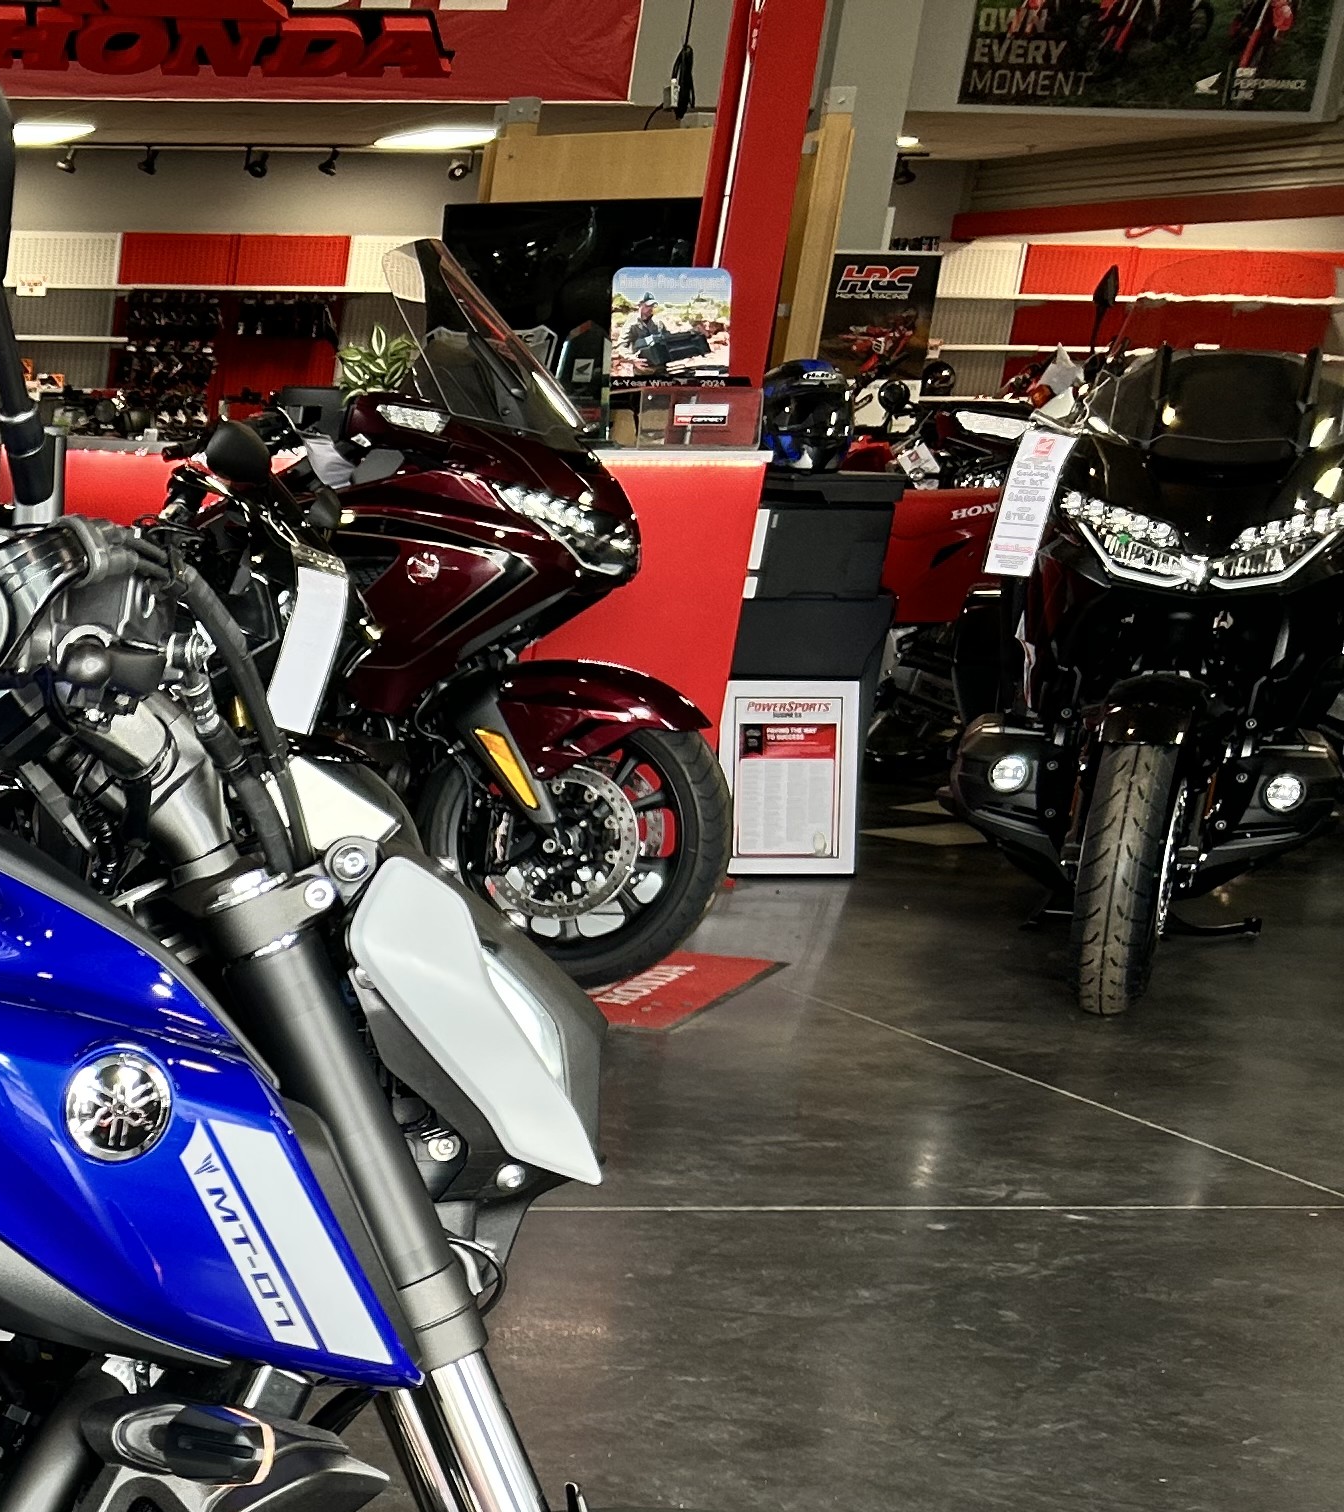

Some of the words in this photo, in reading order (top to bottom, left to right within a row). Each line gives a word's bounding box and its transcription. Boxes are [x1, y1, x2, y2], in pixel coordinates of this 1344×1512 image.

[978, 7, 1049, 33] OWN
[973, 39, 1066, 64] EVERY
[968, 70, 1093, 96] MOMENT
[1230, 89, 1255, 101] LINE
[1232, 78, 1308, 91] PERFORMANCE
[836, 265, 920, 294] HRC
[612, 379, 647, 388] 4-Year
[701, 379, 726, 388] 2024
[592, 964, 696, 1006] HONDA
[206, 1187, 296, 1327] MT-07
